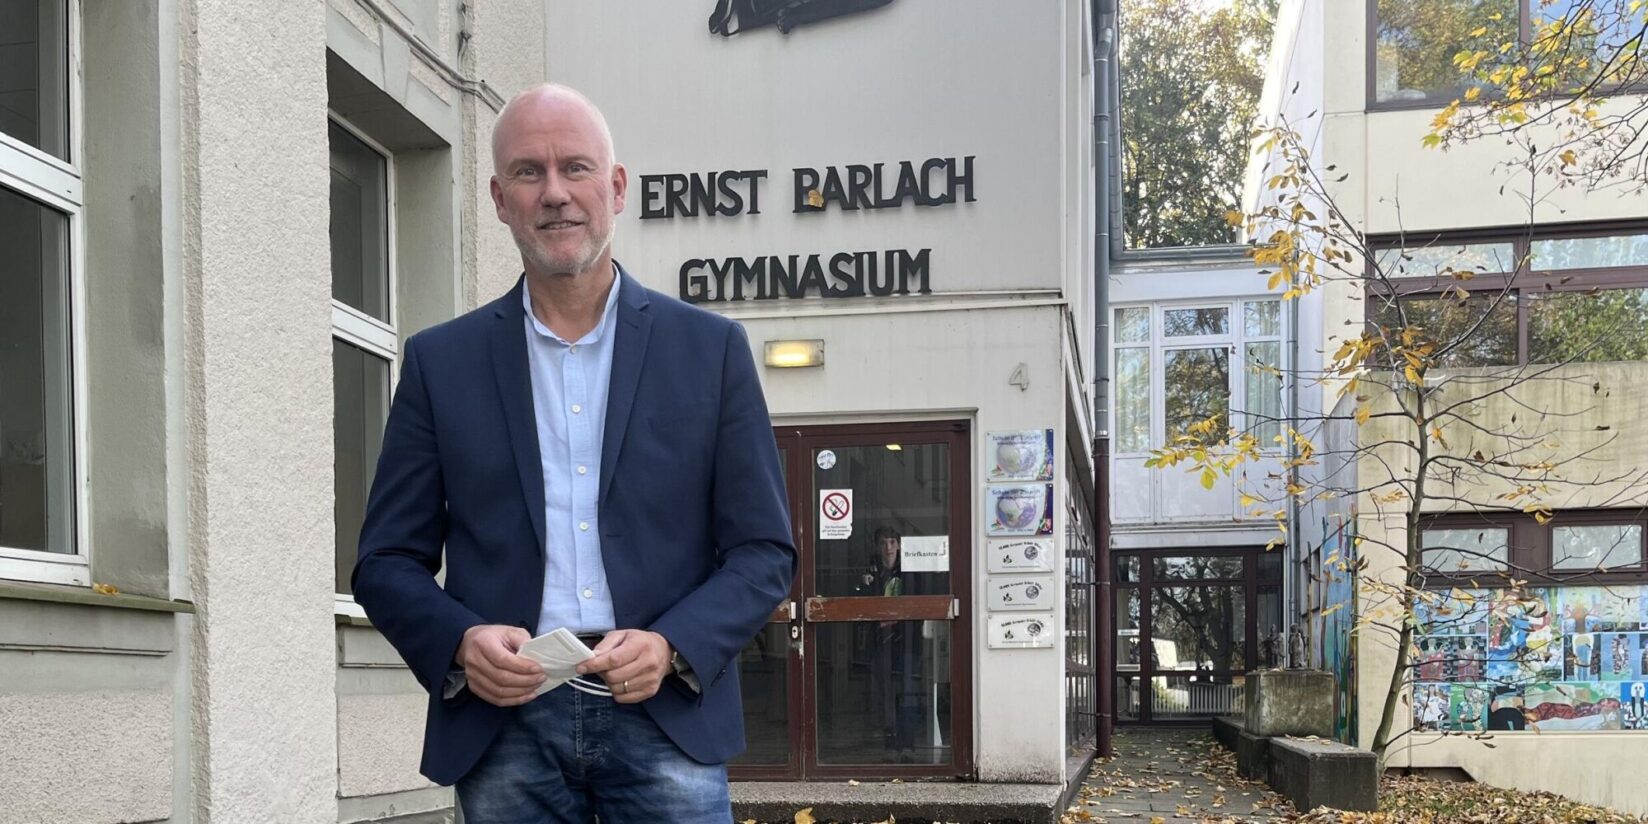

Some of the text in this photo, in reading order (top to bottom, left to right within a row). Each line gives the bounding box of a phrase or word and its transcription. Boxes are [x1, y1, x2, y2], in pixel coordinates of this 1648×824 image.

[639, 155, 977, 219] ERNST BARLACH
[679, 248, 932, 301] GYMNASIUM
[1008, 362, 1029, 391] 4
